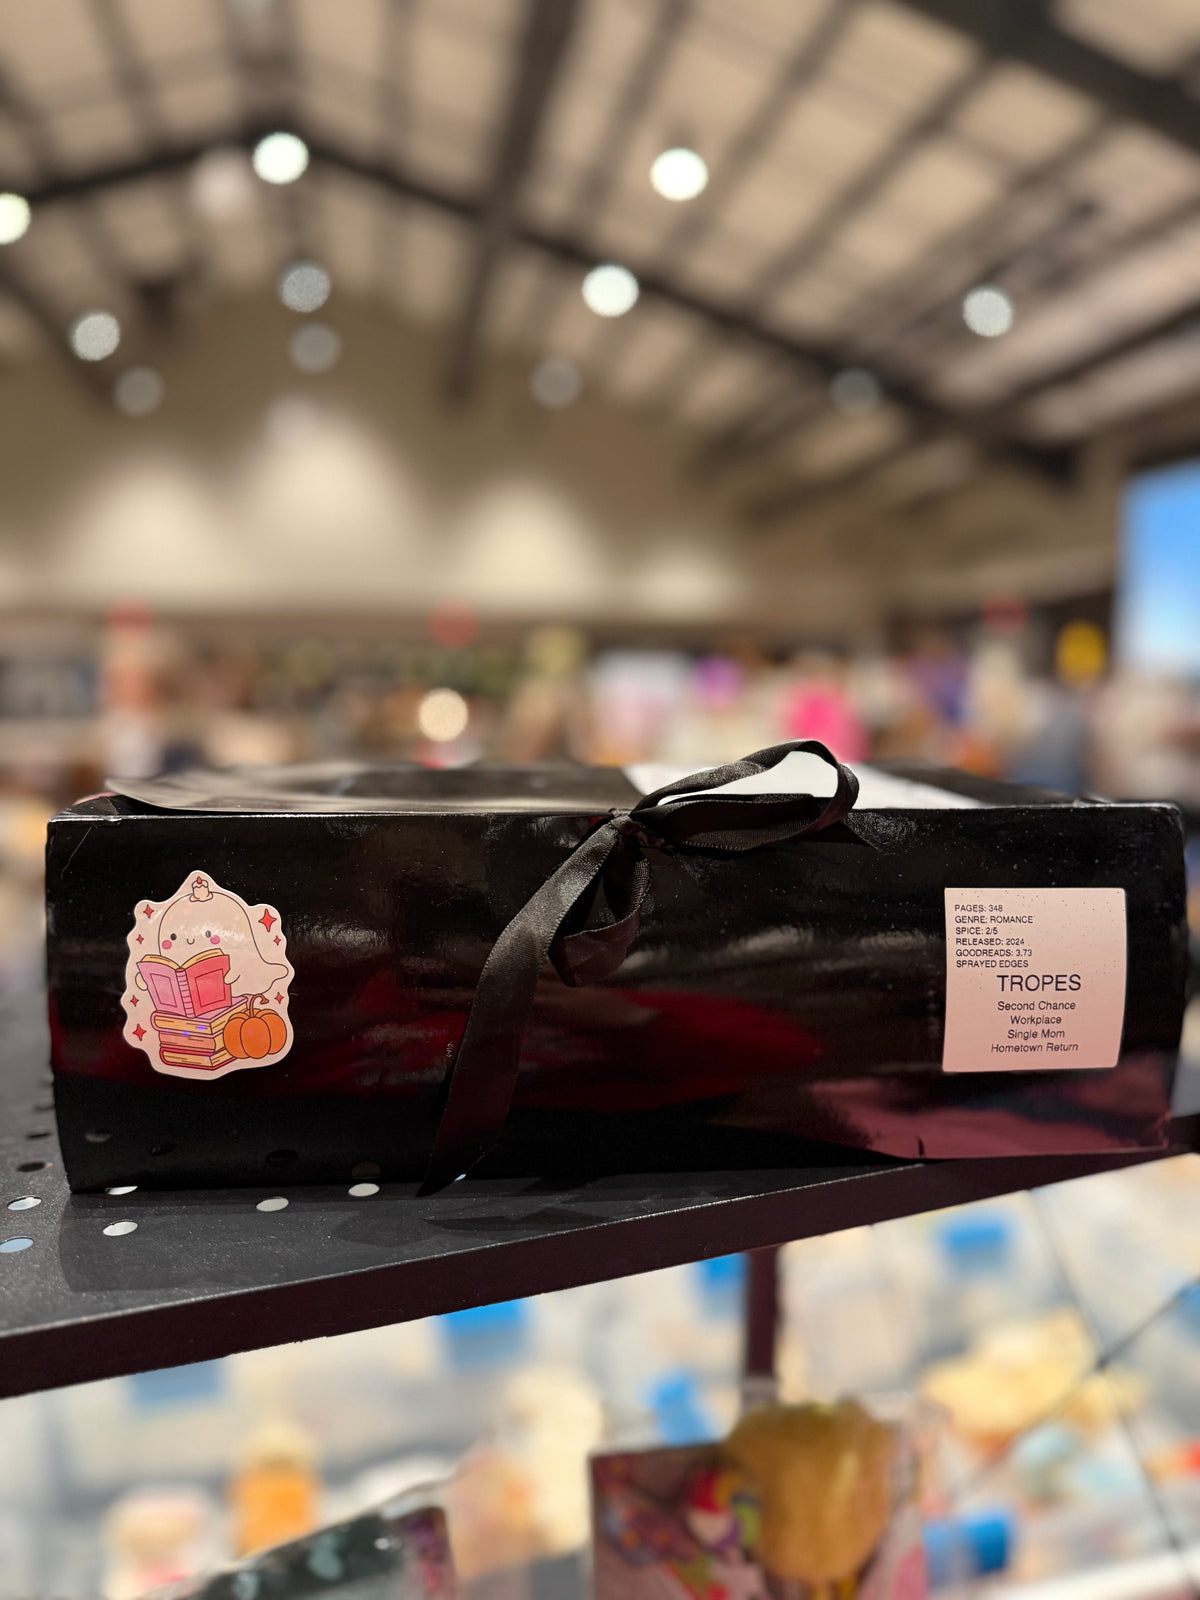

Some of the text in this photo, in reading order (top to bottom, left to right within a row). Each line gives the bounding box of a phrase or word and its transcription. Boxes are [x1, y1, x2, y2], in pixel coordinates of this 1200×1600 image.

[954, 904, 1004, 913] PAGES: 348
[954, 915, 1034, 924] GENRE: ROMANCE
[955, 926, 998, 935] SPICE: 2/5
[955, 938, 1025, 946] RELEASED: 2024
[955, 948, 1033, 957] GOODREADS: 3.73
[956, 959, 1029, 968] SPRAYED EDGES
[996, 974, 1082, 992] TROPES
[997, 1000, 1076, 1011] Second Chance
[1010, 1015, 1062, 1026] Workplace
[1007, 1028, 1065, 1040] Single Mom
[991, 1042, 1079, 1053] Hometown Return
